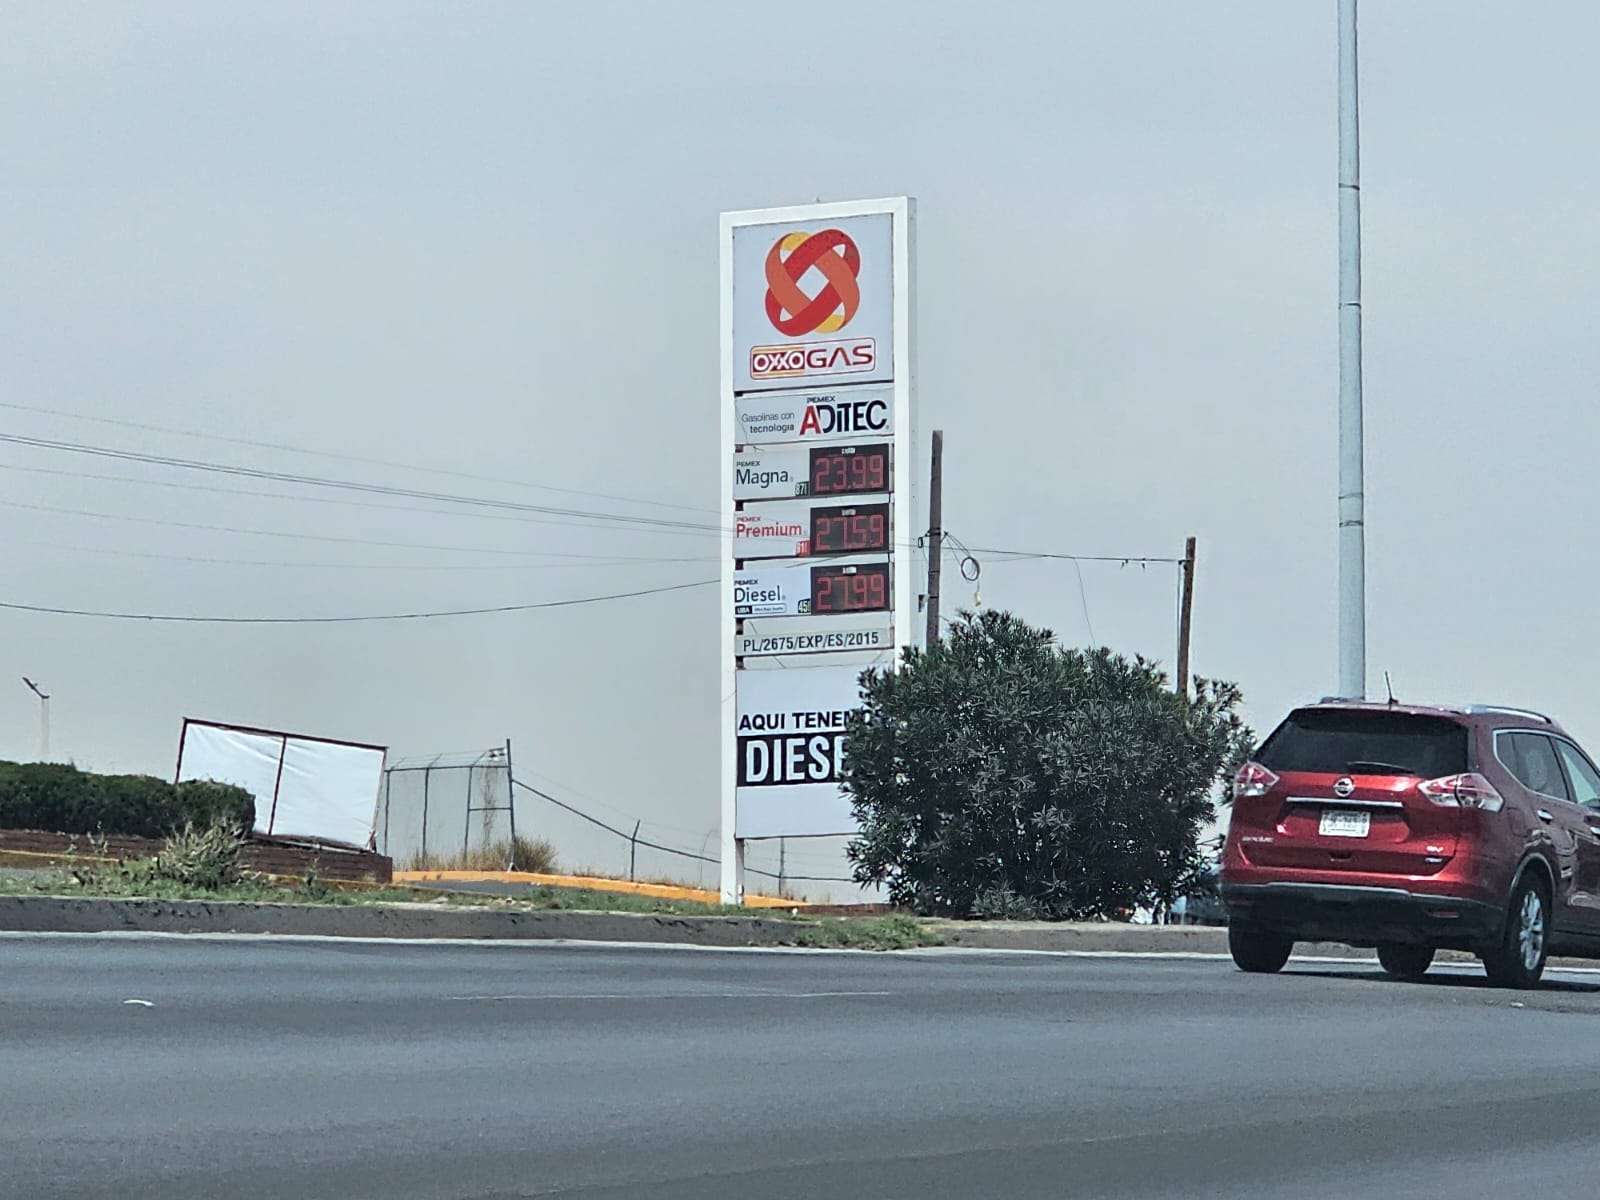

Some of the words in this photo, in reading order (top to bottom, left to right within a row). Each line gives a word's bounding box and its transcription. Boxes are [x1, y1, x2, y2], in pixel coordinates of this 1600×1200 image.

[741, 412, 779, 422] Gasolinas
[780, 412, 795, 420] con
[736, 468, 789, 488] Magna
[736, 521, 802, 538] Premium
[734, 585, 781, 603] Diesel
[743, 632, 879, 652] PL/2675/EXP/ES/2015
[739, 713, 785, 730] AQUI
[746, 735, 851, 783] DIESE
